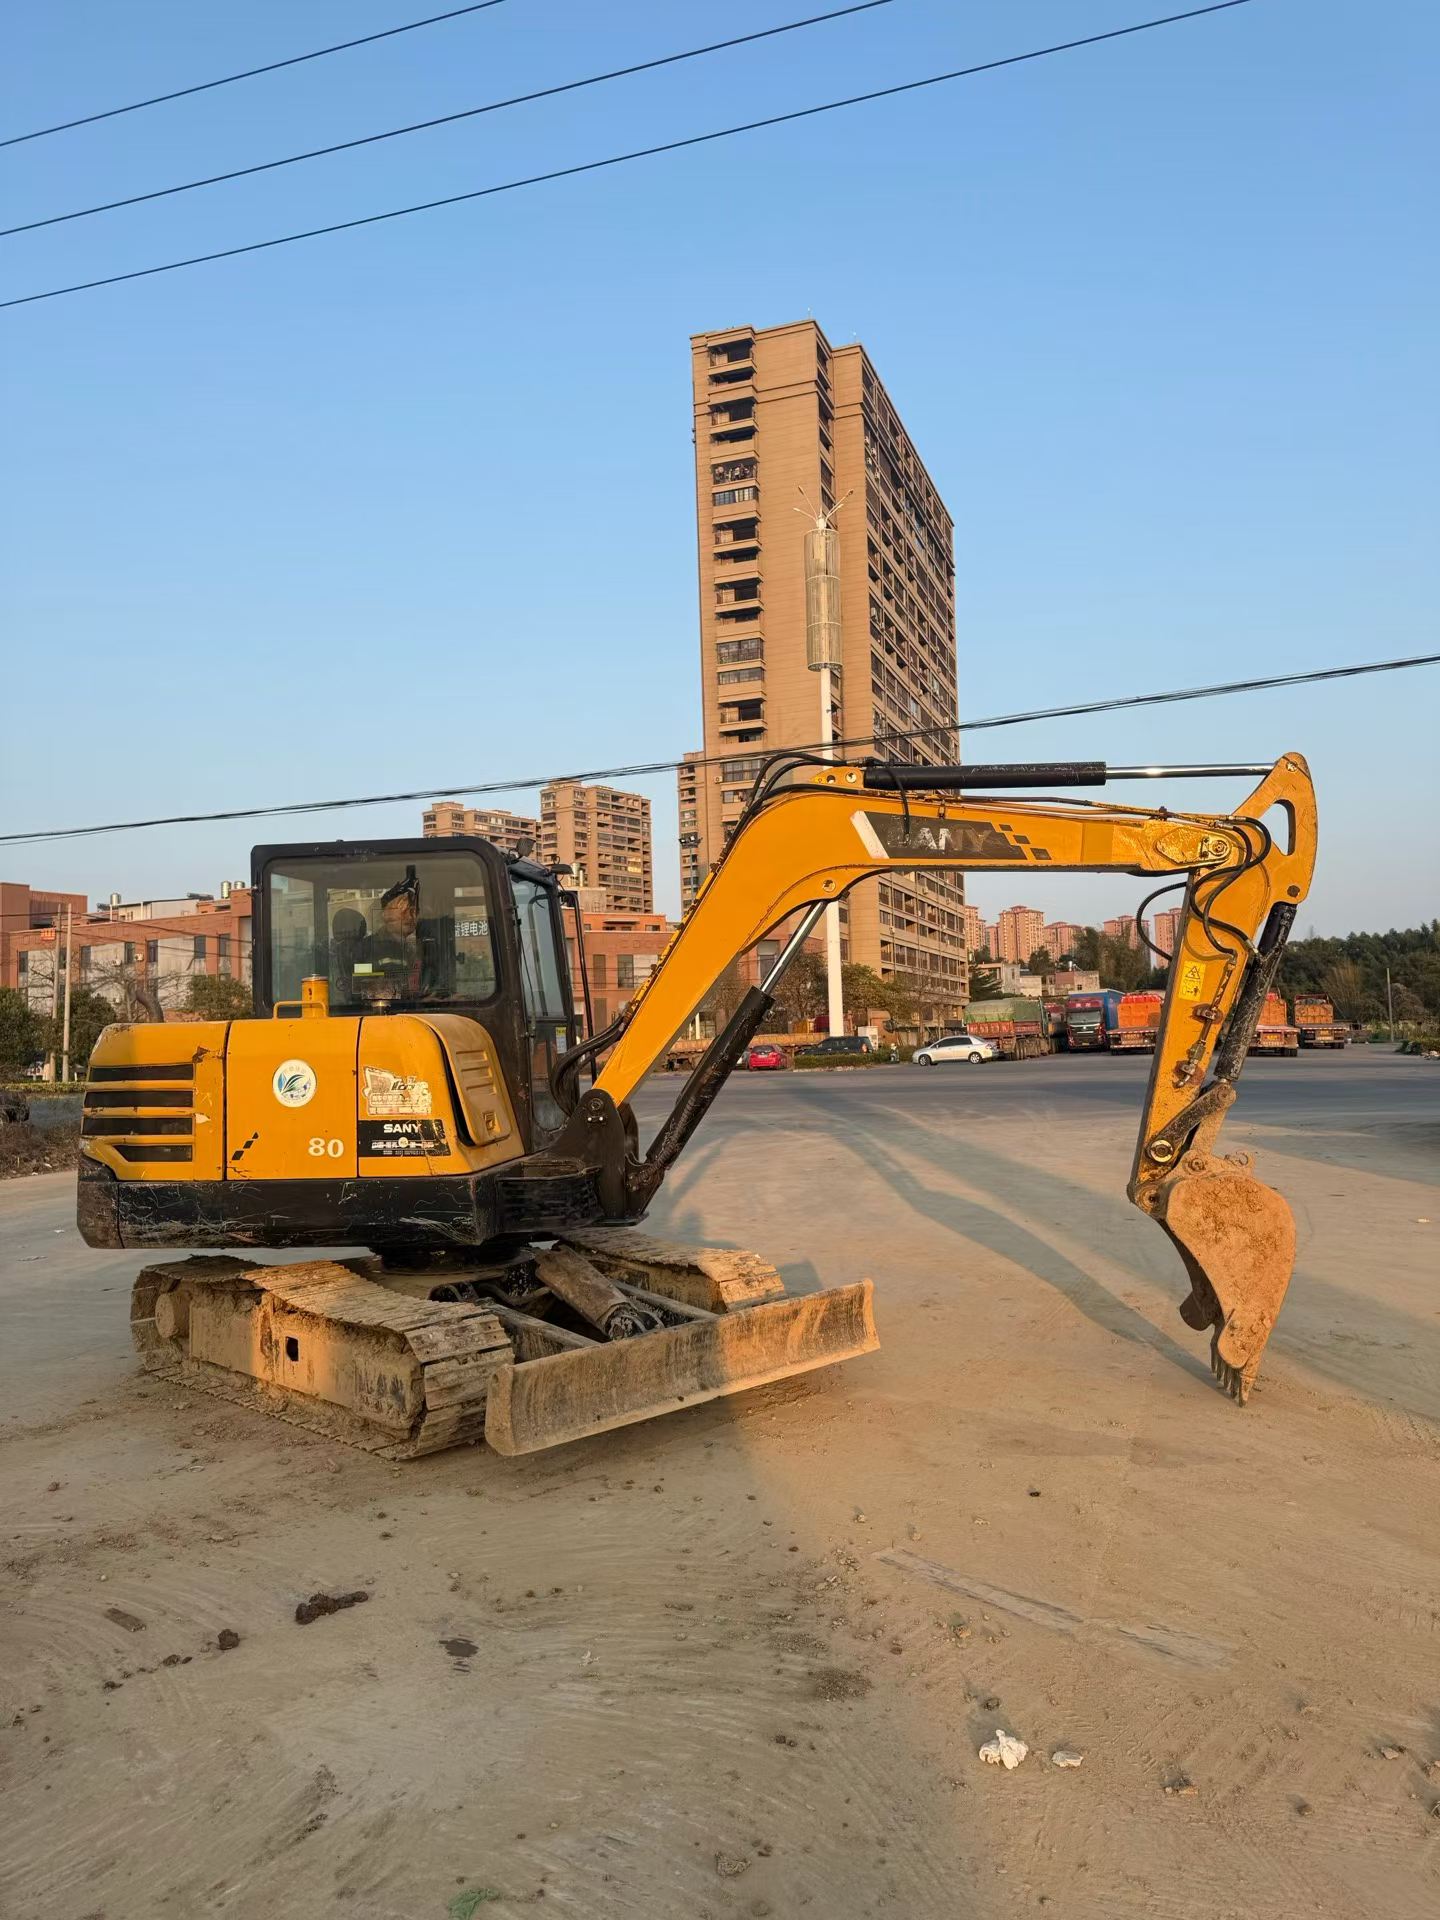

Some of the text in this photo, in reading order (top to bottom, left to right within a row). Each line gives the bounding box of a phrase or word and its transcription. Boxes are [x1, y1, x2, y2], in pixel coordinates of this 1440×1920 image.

[886, 821, 993, 852] ANY
[383, 1123, 421, 1134] SANY
[308, 1137, 344, 1158] 80
